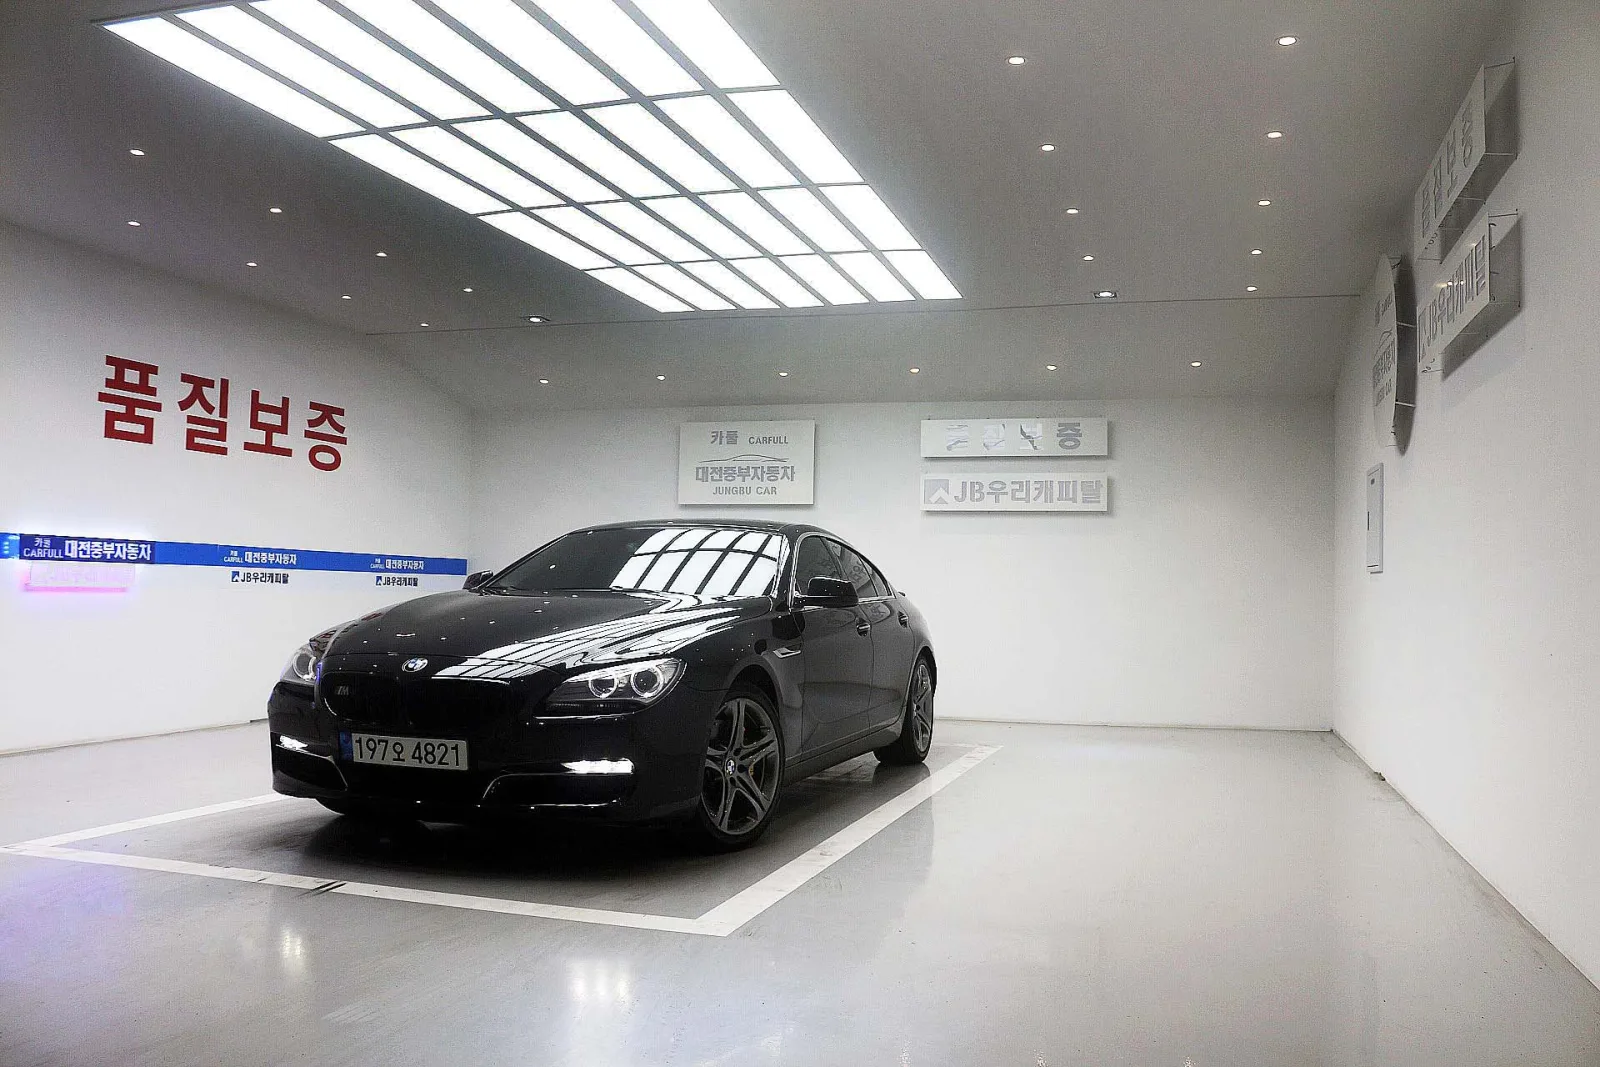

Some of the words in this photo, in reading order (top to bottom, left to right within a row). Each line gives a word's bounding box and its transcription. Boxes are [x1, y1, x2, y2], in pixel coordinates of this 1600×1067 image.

[98, 355, 347, 471] 품질보증
[748, 436, 789, 445] CARFULL
[695, 465, 795, 482] 대전중부자동차
[712, 486, 752, 495] JUNGBU
[756, 486, 777, 495] CAR
[953, 480, 1103, 504] JB우리캐피탈
[23, 547, 64, 559] CARFULL
[64, 539, 152, 560] 대전중부자동차
[240, 572, 289, 585] JB우리캐피탈
[354, 736, 406, 763] 197오
[411, 741, 461, 767] 4821
